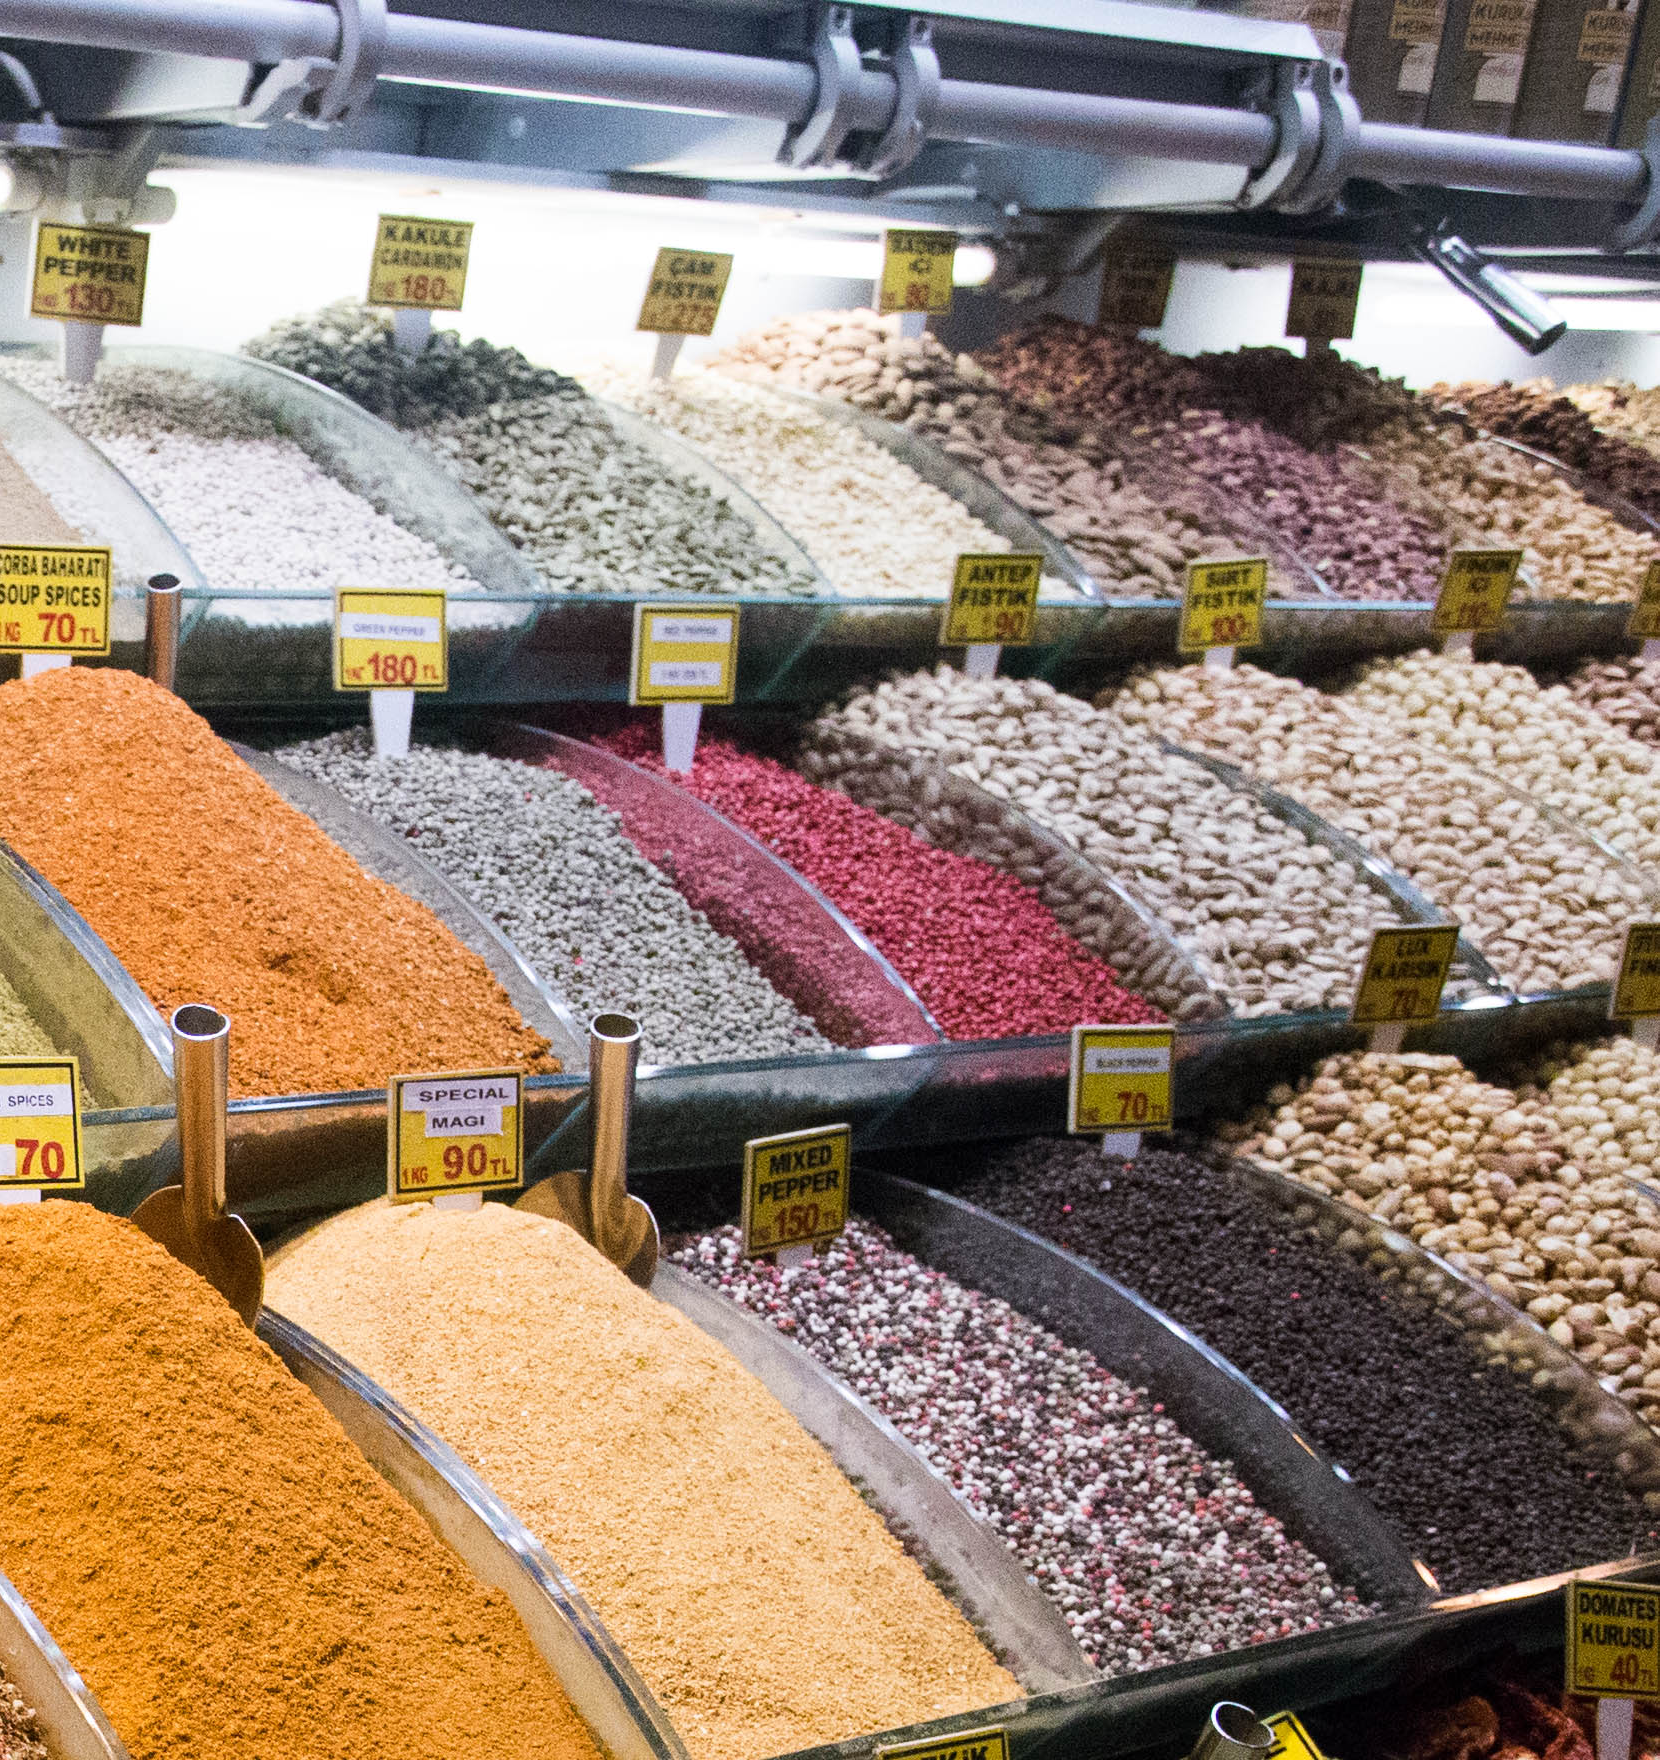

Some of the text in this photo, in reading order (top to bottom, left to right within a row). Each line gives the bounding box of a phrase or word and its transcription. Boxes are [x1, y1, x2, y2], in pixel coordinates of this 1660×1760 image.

[57, 234, 130, 260] WHITE
[42, 256, 137, 283] PEPPER
[63, 282, 115, 314] 130
[401, 273, 447, 301] 180
[45, 584, 102, 608] SPICES
[37, 612, 102, 644] 70 TL
[367, 651, 419, 686] 180
[8, 1094, 55, 1108] SPICES
[418, 1087, 510, 1104] SPECIAL
[1117, 1091, 1151, 1122] 70
[431, 1115, 486, 1130] MAGI
[15, 1137, 65, 1180] 70
[442, 1143, 513, 1181] 90 TL
[769, 1144, 833, 1177] MIXED
[758, 1169, 841, 1205] PEPPER
[773, 1203, 820, 1241] 150
[1579, 1592, 1657, 1621] DOMATES
[1581, 1623, 1655, 1650] KURUSU
[1609, 1653, 1640, 1685] 40
